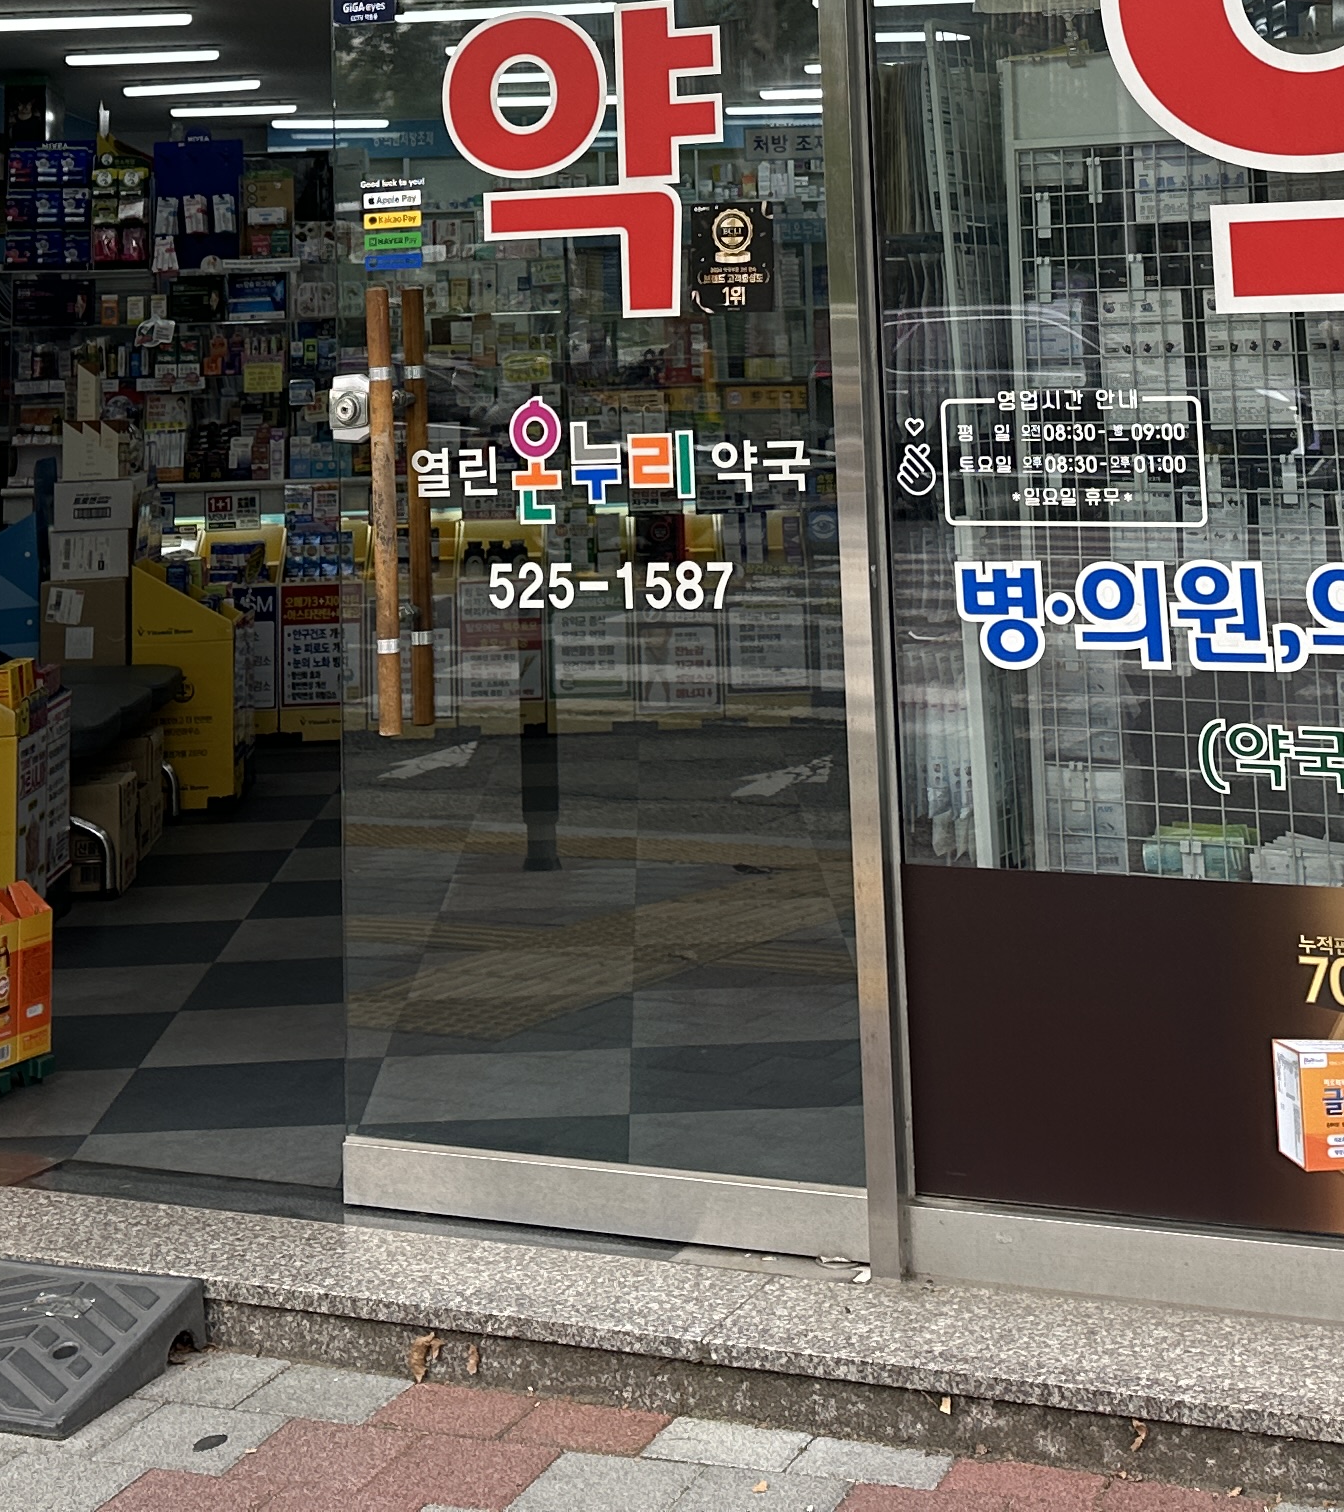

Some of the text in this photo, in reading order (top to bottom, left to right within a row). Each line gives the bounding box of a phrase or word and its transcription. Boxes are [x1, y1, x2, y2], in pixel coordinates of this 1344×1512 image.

[753, 134, 788, 153] 처방
[376, 194, 417, 205] Apple Pay
[722, 286, 746, 306] 1위
[996, 388, 1139, 412] 영업시간 안내
[410, 396, 813, 527] 열린 온누리 약국
[958, 456, 1012, 475] 토요일
[209, 497, 232, 512] 1+1
[488, 560, 734, 610] 525-1587
